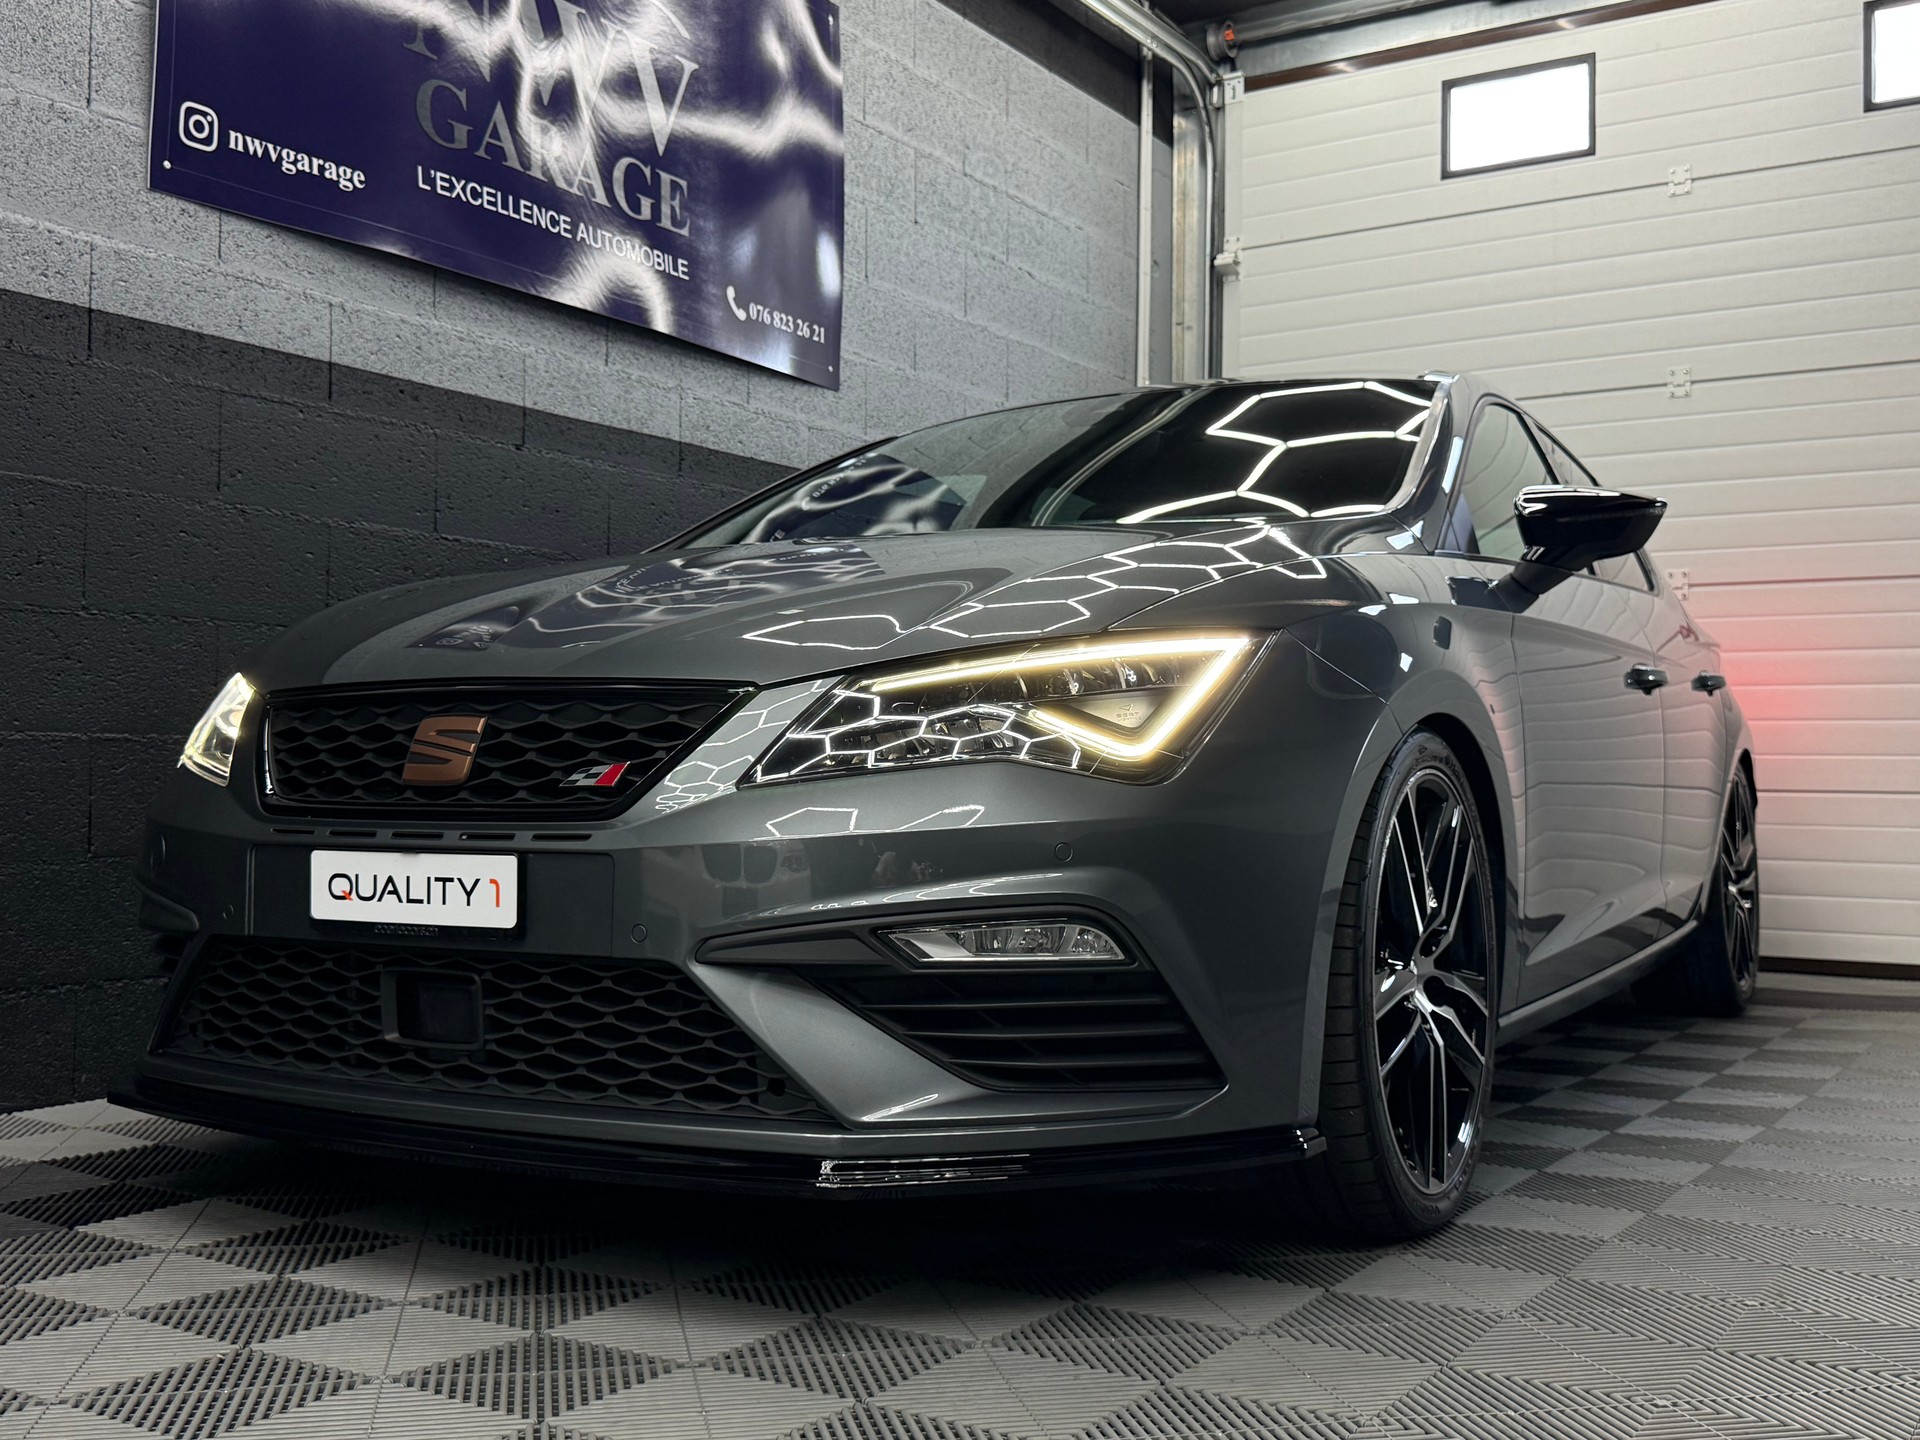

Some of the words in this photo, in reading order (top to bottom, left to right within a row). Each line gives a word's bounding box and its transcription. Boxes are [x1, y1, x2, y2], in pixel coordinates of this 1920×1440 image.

[228, 129, 366, 192] nwvgarage
[416, 79, 691, 237] GARAGE
[576, 222, 690, 281] AUTOMOBILE
[748, 301, 772, 326] 076
[772, 310, 795, 333] 823
[796, 318, 811, 339] 26
[812, 324, 826, 344] 21
[328, 872, 481, 907] QUALITY
[489, 878, 501, 908] 1
